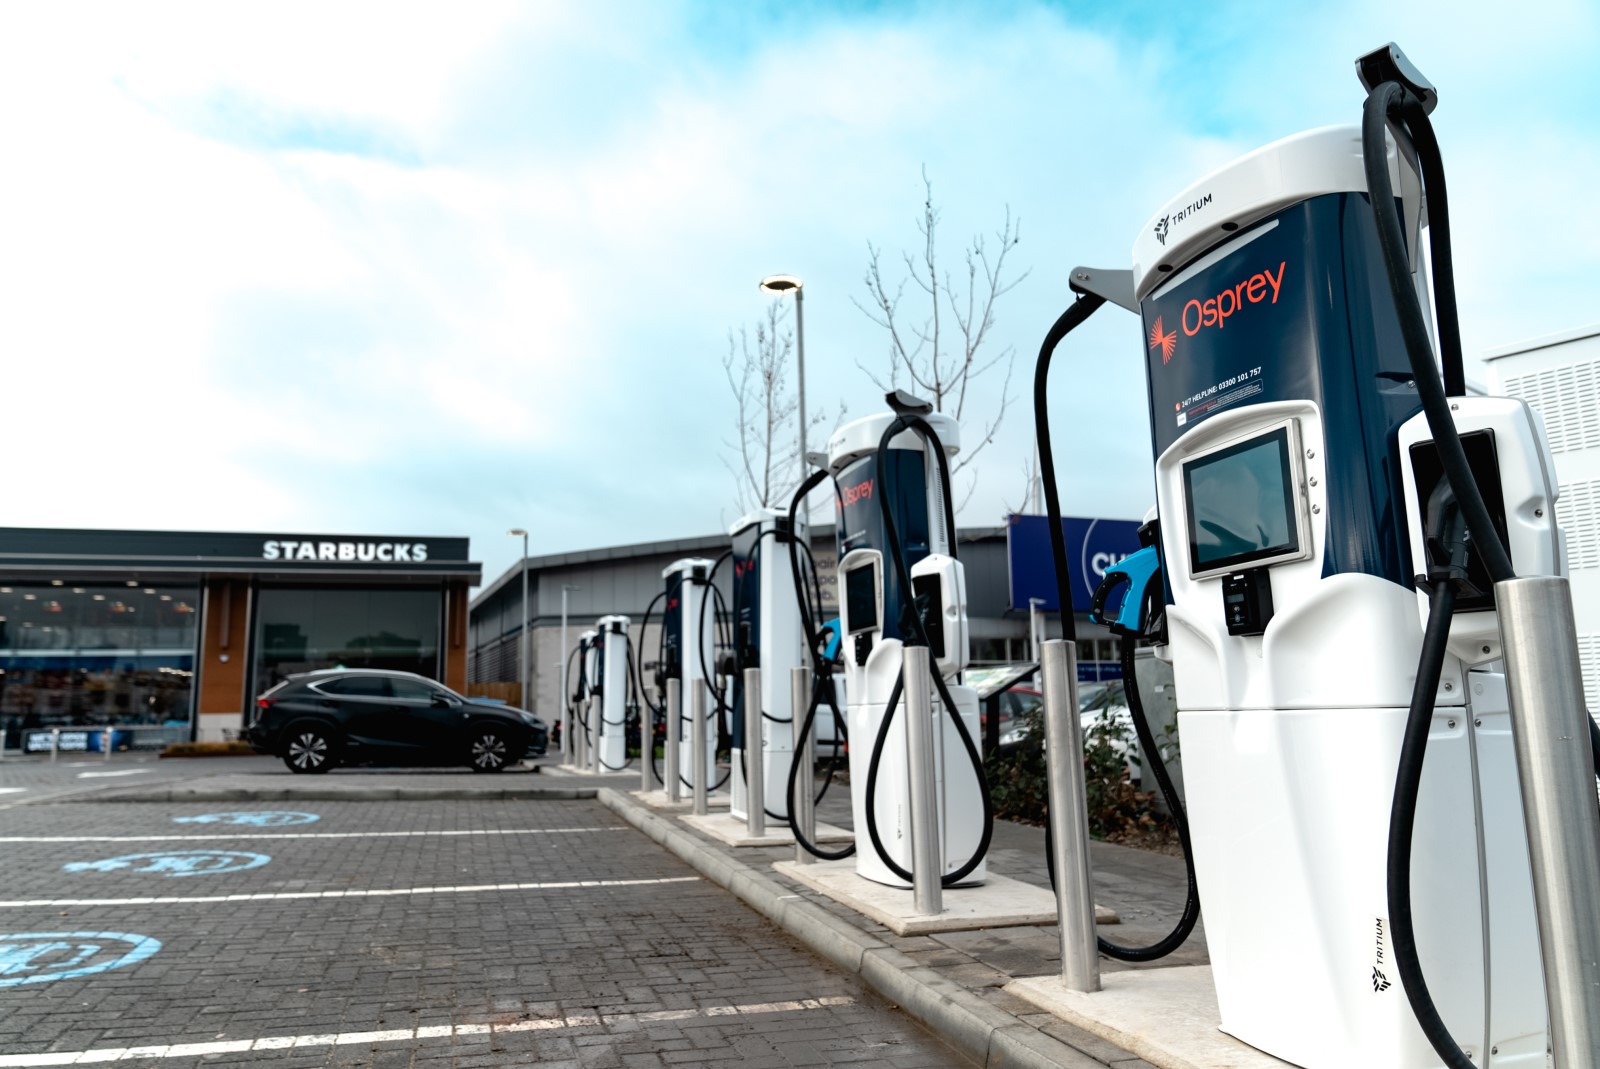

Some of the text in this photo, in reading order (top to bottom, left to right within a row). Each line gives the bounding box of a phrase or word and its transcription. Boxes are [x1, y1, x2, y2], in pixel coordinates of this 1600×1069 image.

[1172, 193, 1212, 225] TRITIUM
[1182, 261, 1286, 336] Osprey
[1192, 385, 1218, 402] HELPLINE:
[1218, 377, 1236, 390] 03300
[1237, 372, 1249, 382] 101
[1249, 366, 1262, 377] 757
[842, 480, 874, 507] Osprey
[262, 540, 428, 562] STARBUCKS
[1376, 917, 1384, 965] TRITIUM
